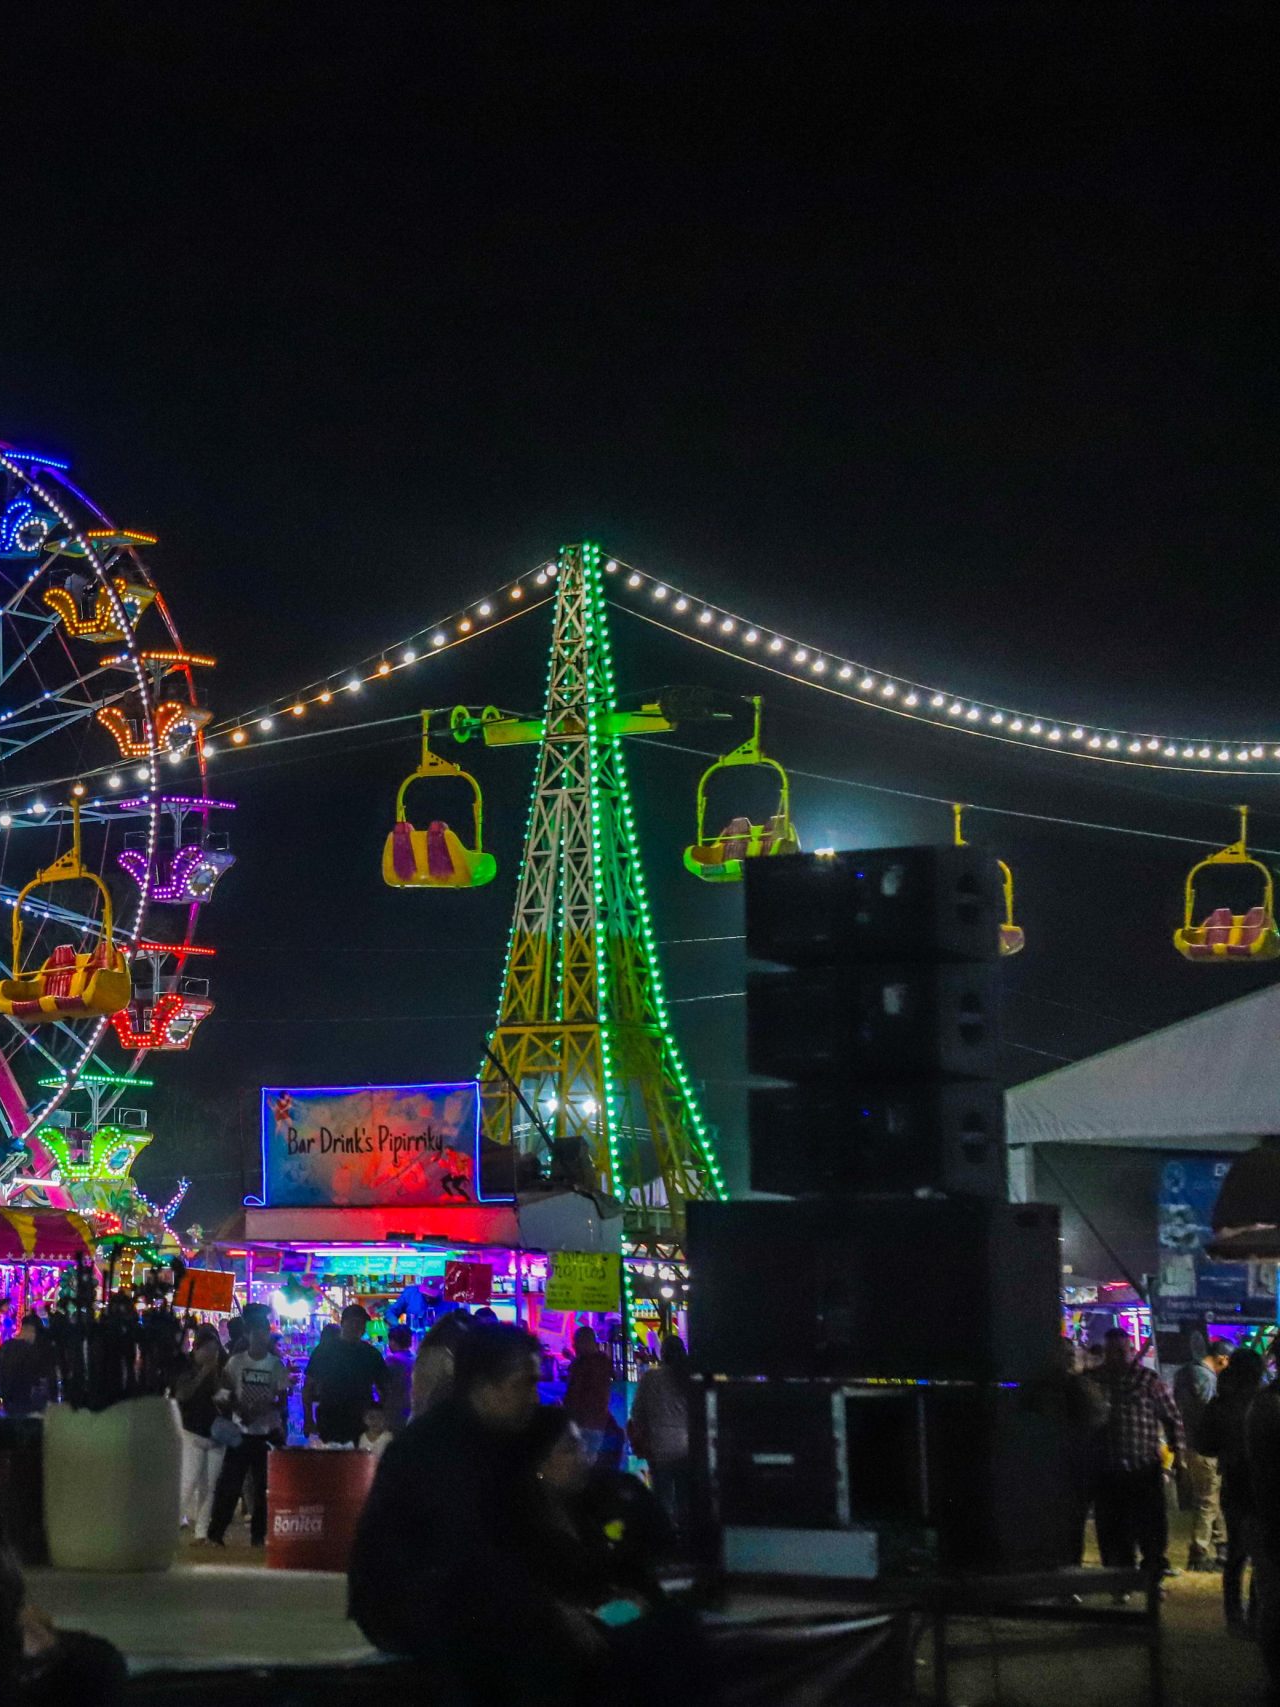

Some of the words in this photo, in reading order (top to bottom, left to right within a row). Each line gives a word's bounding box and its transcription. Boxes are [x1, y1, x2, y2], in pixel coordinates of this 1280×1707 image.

[288, 1127, 315, 1155] Bar
[320, 1127, 373, 1154] Drink's
[378, 1125, 444, 1167] Pipirriky
